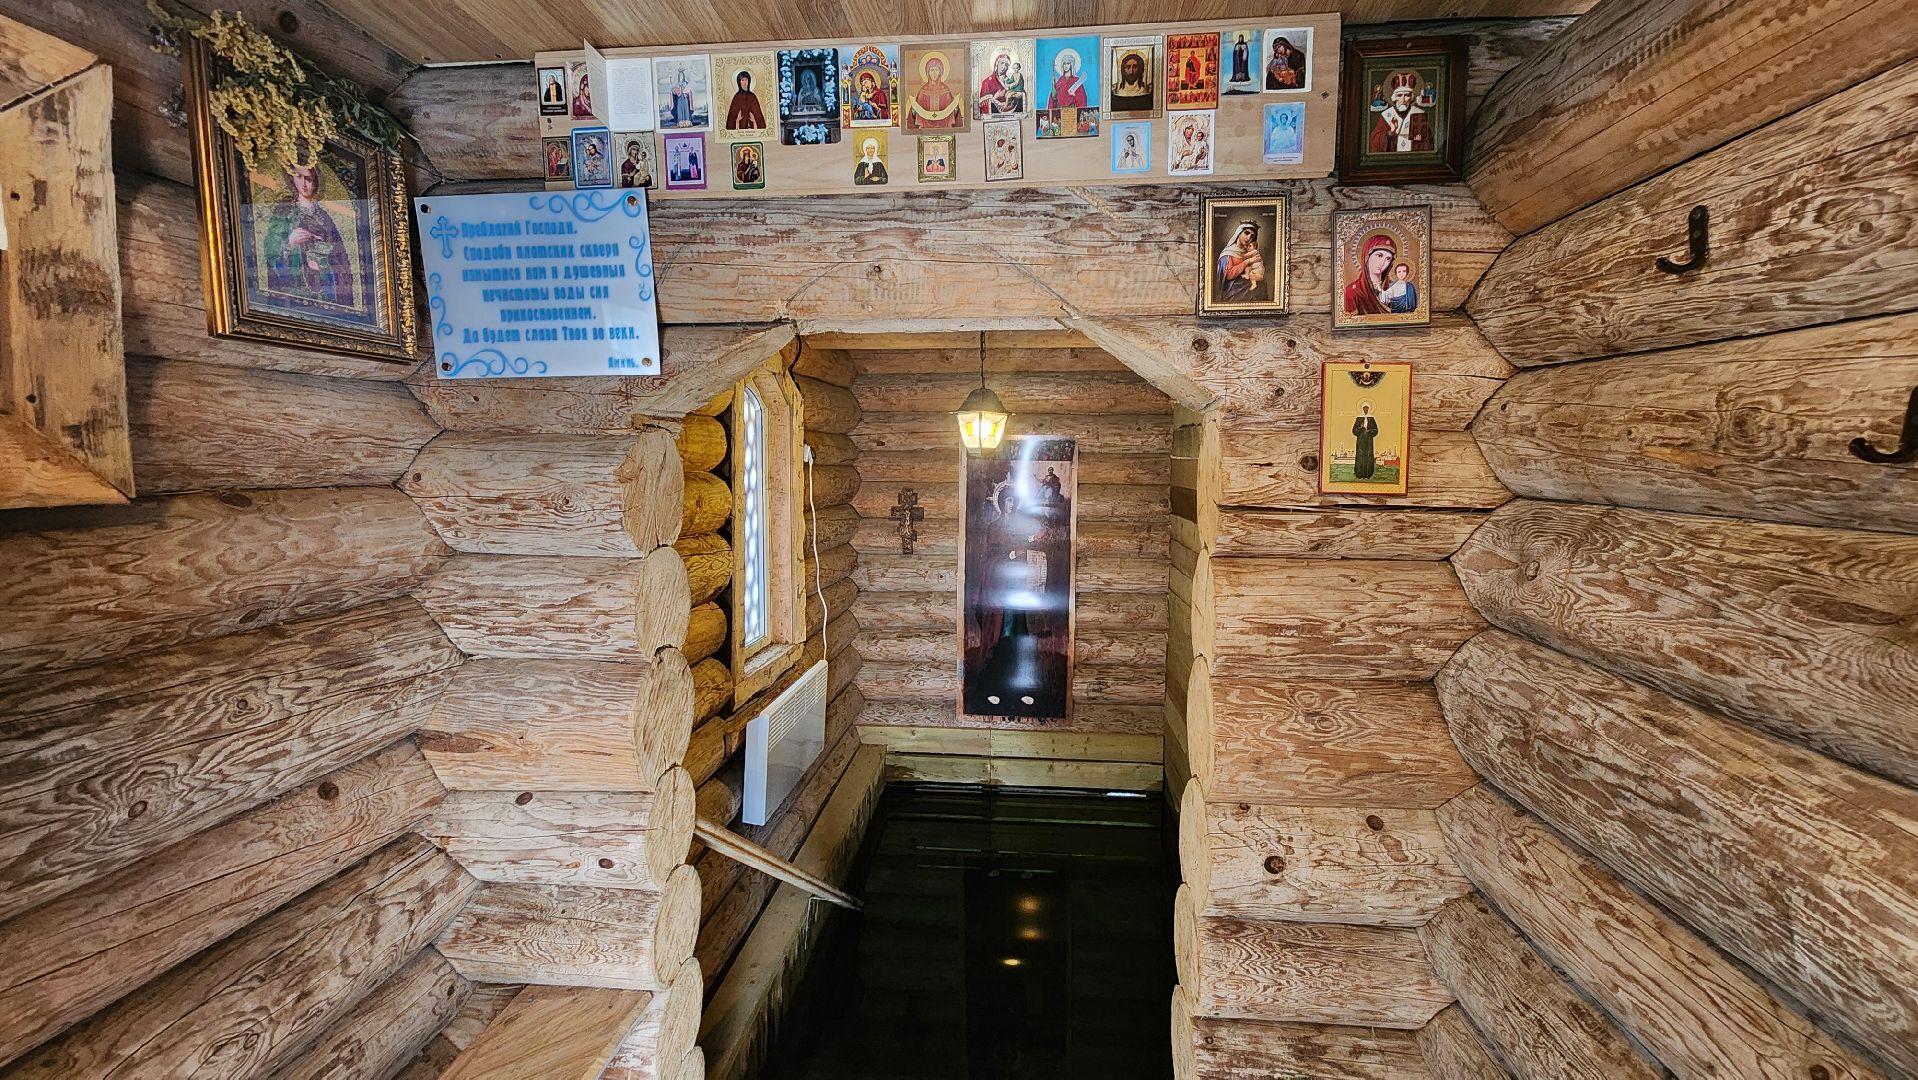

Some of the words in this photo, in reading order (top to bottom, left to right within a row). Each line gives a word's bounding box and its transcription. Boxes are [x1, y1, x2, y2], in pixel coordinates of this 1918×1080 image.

[463, 244, 512, 261] Сподоби
[516, 243, 575, 259] плотских
[580, 243, 619, 258] скверн
[525, 265, 547, 279] нам
[551, 265, 558, 279] и
[563, 264, 625, 280] душевныя
[482, 287, 549, 302] нечистоты
[554, 286, 585, 300] воды
[590, 285, 609, 299] сия
[500, 306, 597, 323] прикосновением.
[463, 328, 479, 344] Да
[482, 327, 521, 344] будет
[525, 327, 558, 342] слава
[561, 326, 588, 341] Твоя
[592, 327, 604, 340] во
[609, 326, 640, 340] веки.
[607, 356, 639, 368] Аминь.
